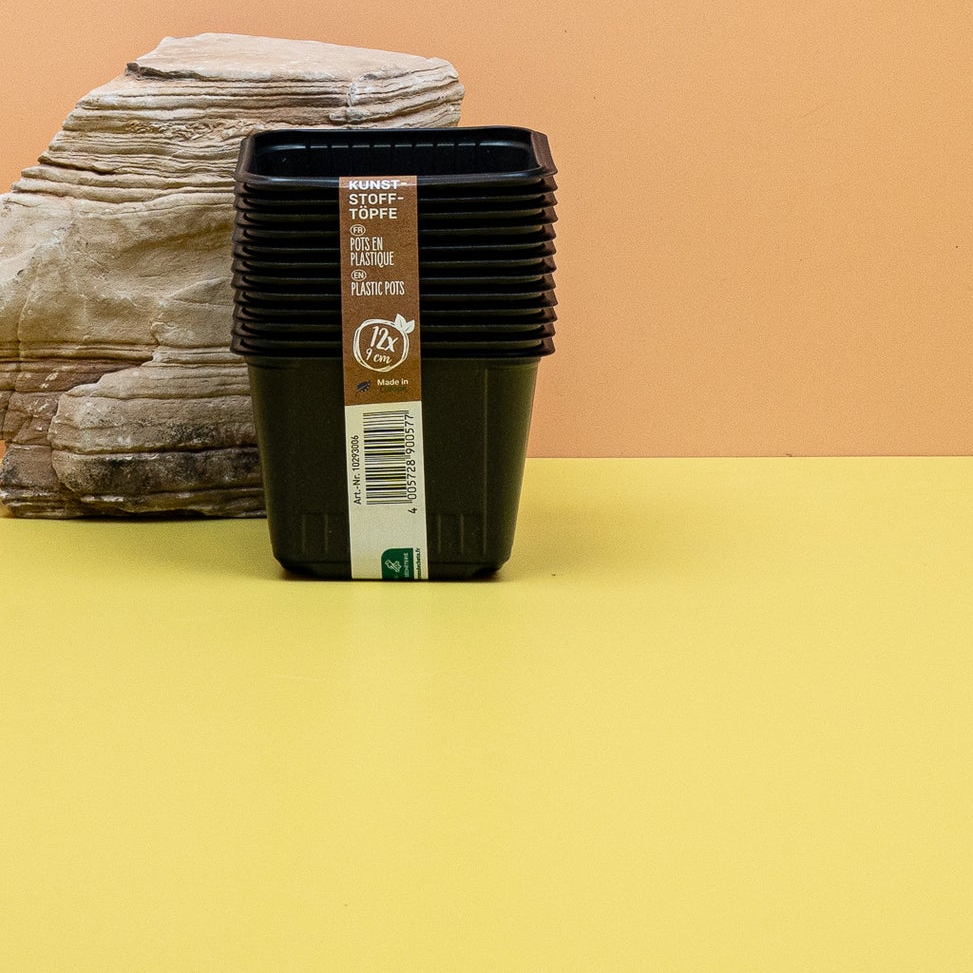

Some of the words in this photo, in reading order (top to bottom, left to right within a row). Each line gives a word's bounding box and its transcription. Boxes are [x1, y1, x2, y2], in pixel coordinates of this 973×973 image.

[349, 180, 407, 190] KUNST-
[349, 193, 404, 205] STOFF-
[349, 206, 397, 220] TÖPFE
[350, 237, 370, 251] POTS
[372, 237, 383, 251] EN
[350, 252, 394, 268] PLASTIQUE
[351, 281, 383, 296] PLASTIC
[384, 281, 405, 295] POTS
[370, 326, 399, 353] 12x
[373, 353, 392, 364] cm
[405, 414, 416, 455] 900577
[351, 435, 360, 471] 10293006
[406, 459, 417, 500] 005728
[353, 473, 361, 505] Art.-Nr.
